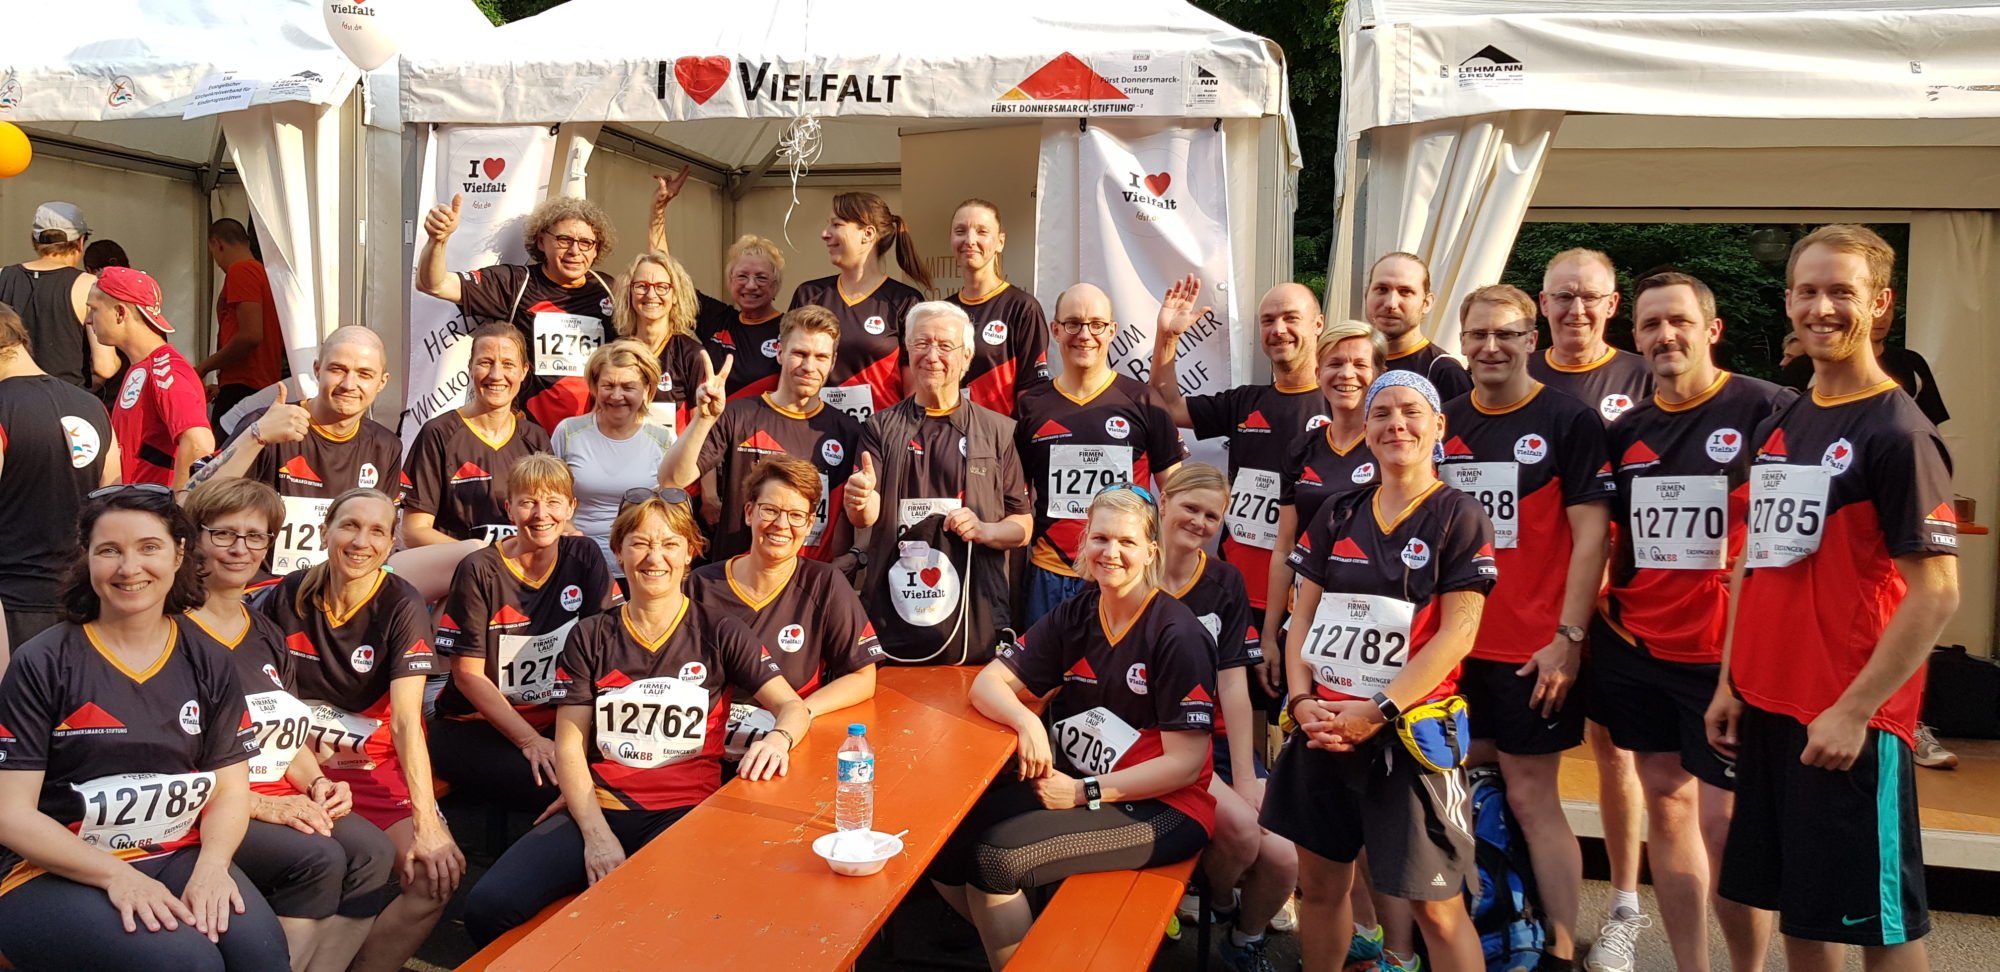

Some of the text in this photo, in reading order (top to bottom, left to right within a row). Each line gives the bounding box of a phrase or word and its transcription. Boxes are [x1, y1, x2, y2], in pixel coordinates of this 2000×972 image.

[331, 5, 376, 16] Vielfalt
[1134, 65, 1148, 73] 159
[1459, 64, 1523, 73] LEHMANN
[657, 60, 902, 104] I VIELFALT
[1122, 75, 1180, 84] Donnersmarck-
[1124, 87, 1155, 96] Stiftung
[991, 103, 1017, 113] FÜRST
[1020, 103, 1134, 113] DONNERSMARCK-STIFTUNG
[468, 160, 481, 178] I
[1129, 172, 1140, 188] I
[463, 183, 507, 193] Vielfalt
[1122, 191, 1177, 210] Vielfalt
[1107, 324, 1147, 368] ZUM
[1127, 310, 1223, 385] BLINER
[1178, 361, 1210, 398] AUF
[1520, 439, 1527, 448] I
[1713, 434, 1720, 444] I
[1078, 451, 1104, 459] FIRMEN
[1516, 449, 1543, 457] Vielfalt
[1456, 470, 1483, 478] FIRMEN
[1761, 473, 1787, 483] FIRMEN
[1254, 476, 1275, 486] FIRMEN
[1656, 484, 1686, 492] FIRMEN
[1661, 491, 1681, 499] LAUF
[1228, 491, 1280, 525] 1276
[1633, 506, 1725, 540] 12770
[1405, 542, 1413, 552] I
[1403, 553, 1427, 562] Vielfalt
[907, 571, 918, 587] I
[902, 589, 945, 600] Vielfalt
[1347, 602, 1371, 612] FIRMEN
[1350, 610, 1367, 619] LAUF
[533, 636, 559, 649] FIRMEN
[1308, 623, 1406, 668] 12782
[538, 643, 555, 653] LAUF
[501, 654, 555, 688] 127
[251, 698, 278, 707] FIRMEN
[182, 706, 190, 717] I
[259, 703, 277, 713] LAUF
[599, 701, 705, 740] 12762
[1086, 710, 1107, 725] FIRMEN
[254, 716, 310, 751] 2780
[310, 725, 364, 754] 777
[1055, 721, 1118, 775] 12793
[89, 776, 212, 827] 12783
